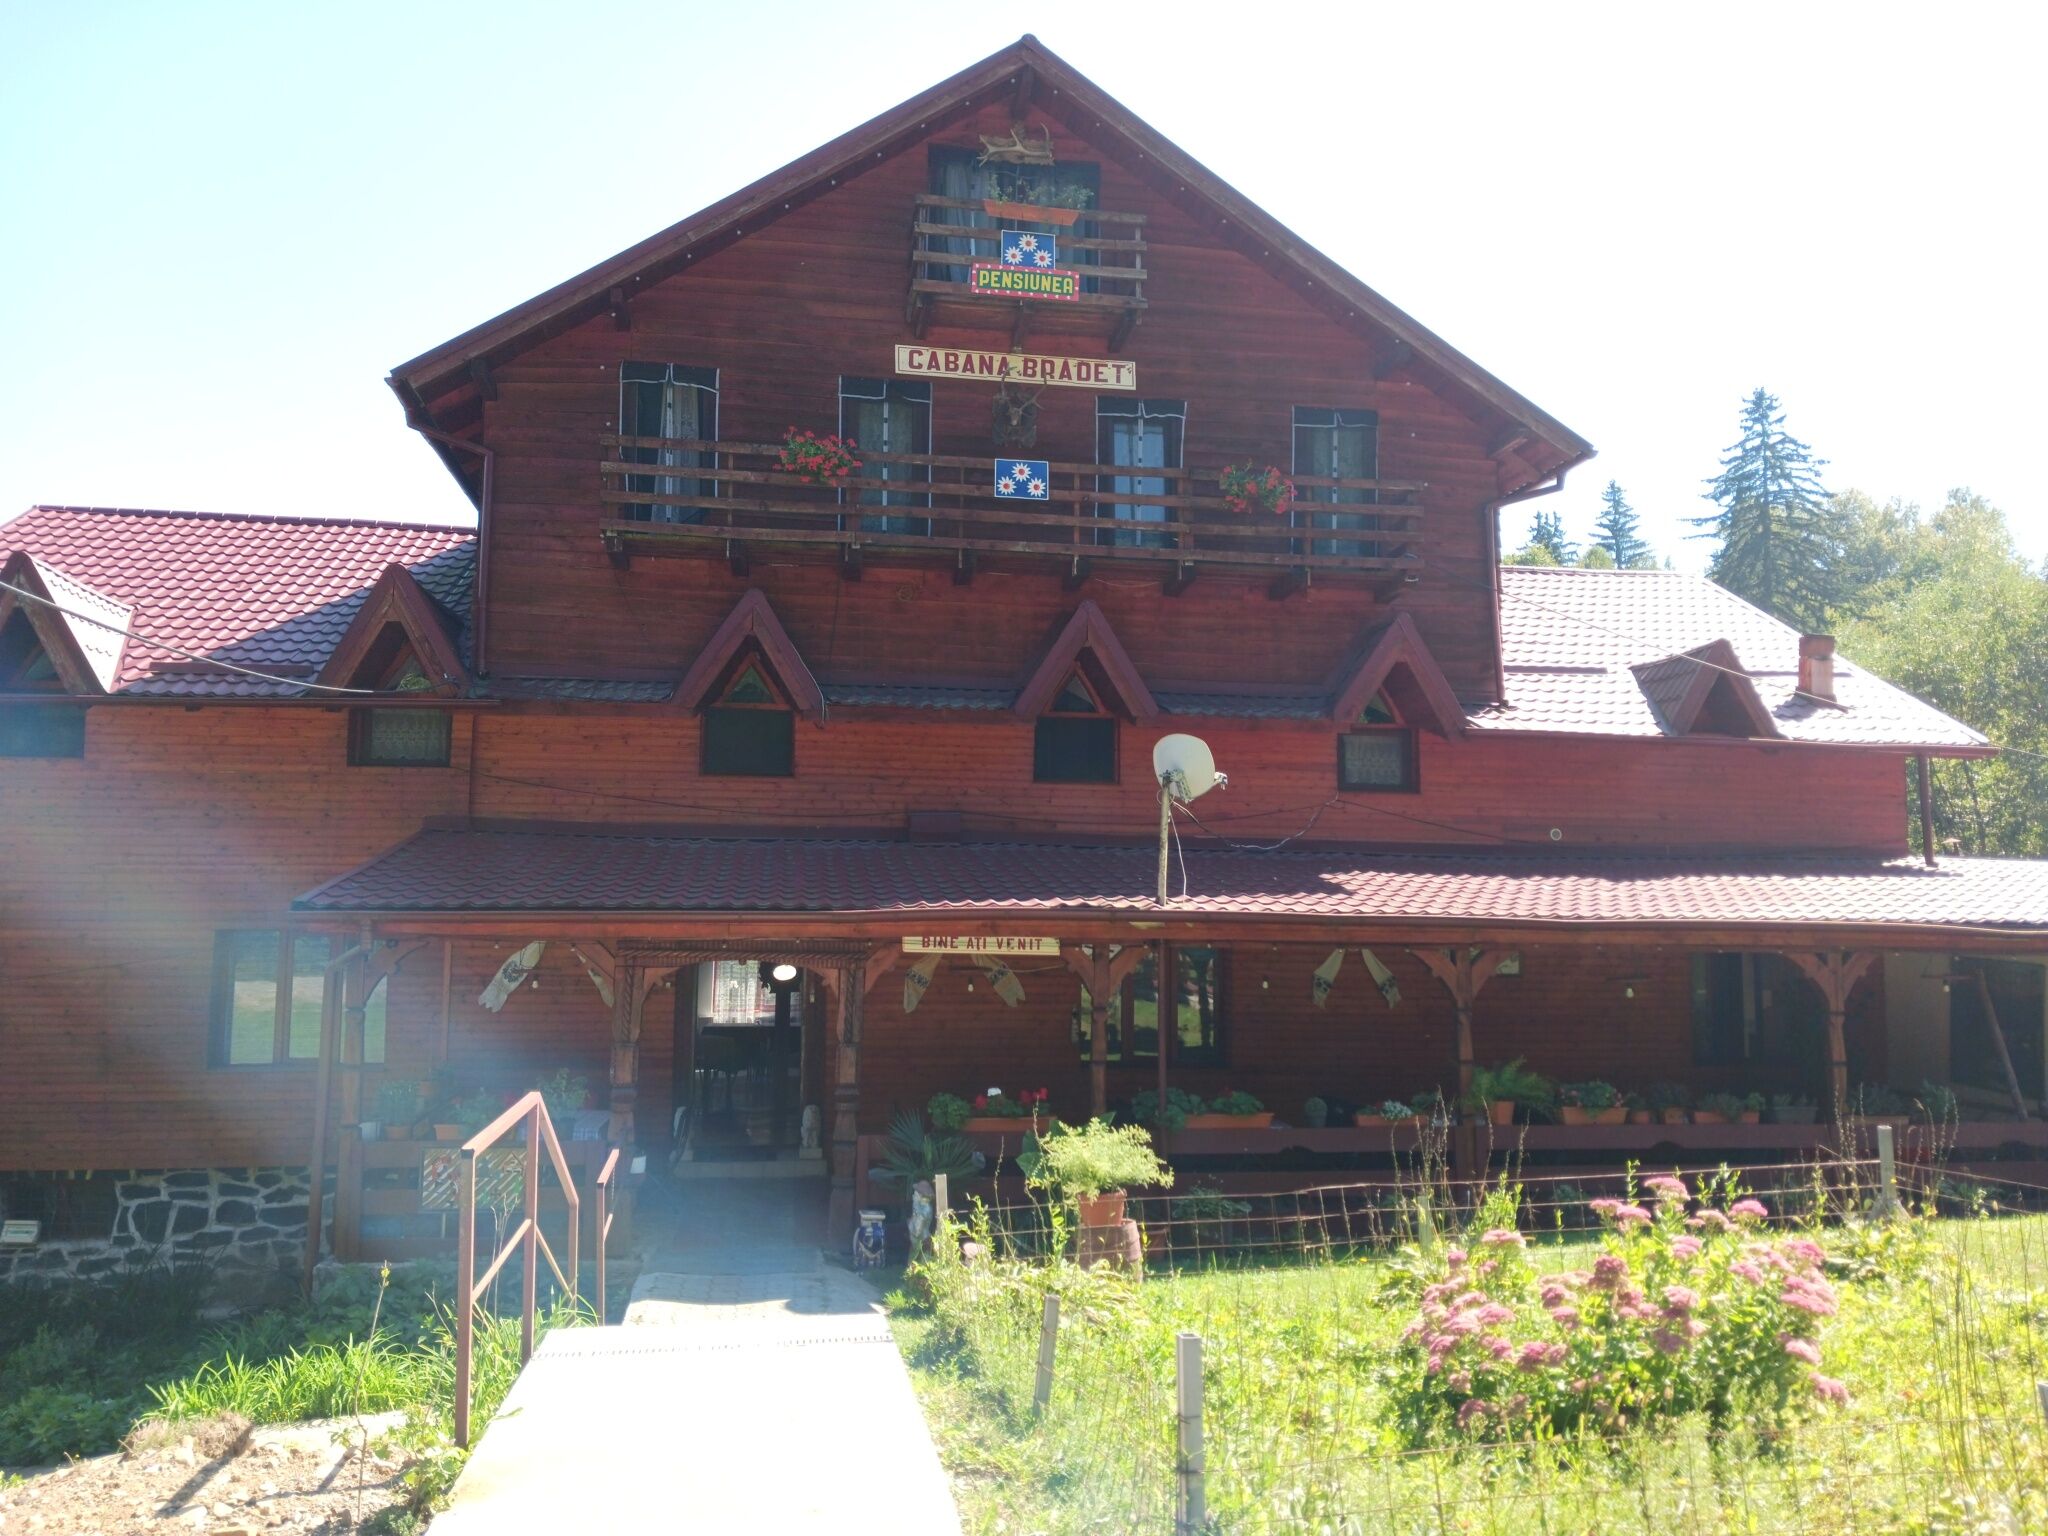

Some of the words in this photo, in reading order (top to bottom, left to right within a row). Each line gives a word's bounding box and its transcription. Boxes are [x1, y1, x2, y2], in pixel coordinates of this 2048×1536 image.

[979, 271, 1074, 294] PENSIUNEA
[908, 349, 1011, 376] CABANA
[922, 937, 958, 949] BINE
[997, 938, 1043, 950] VENIT
